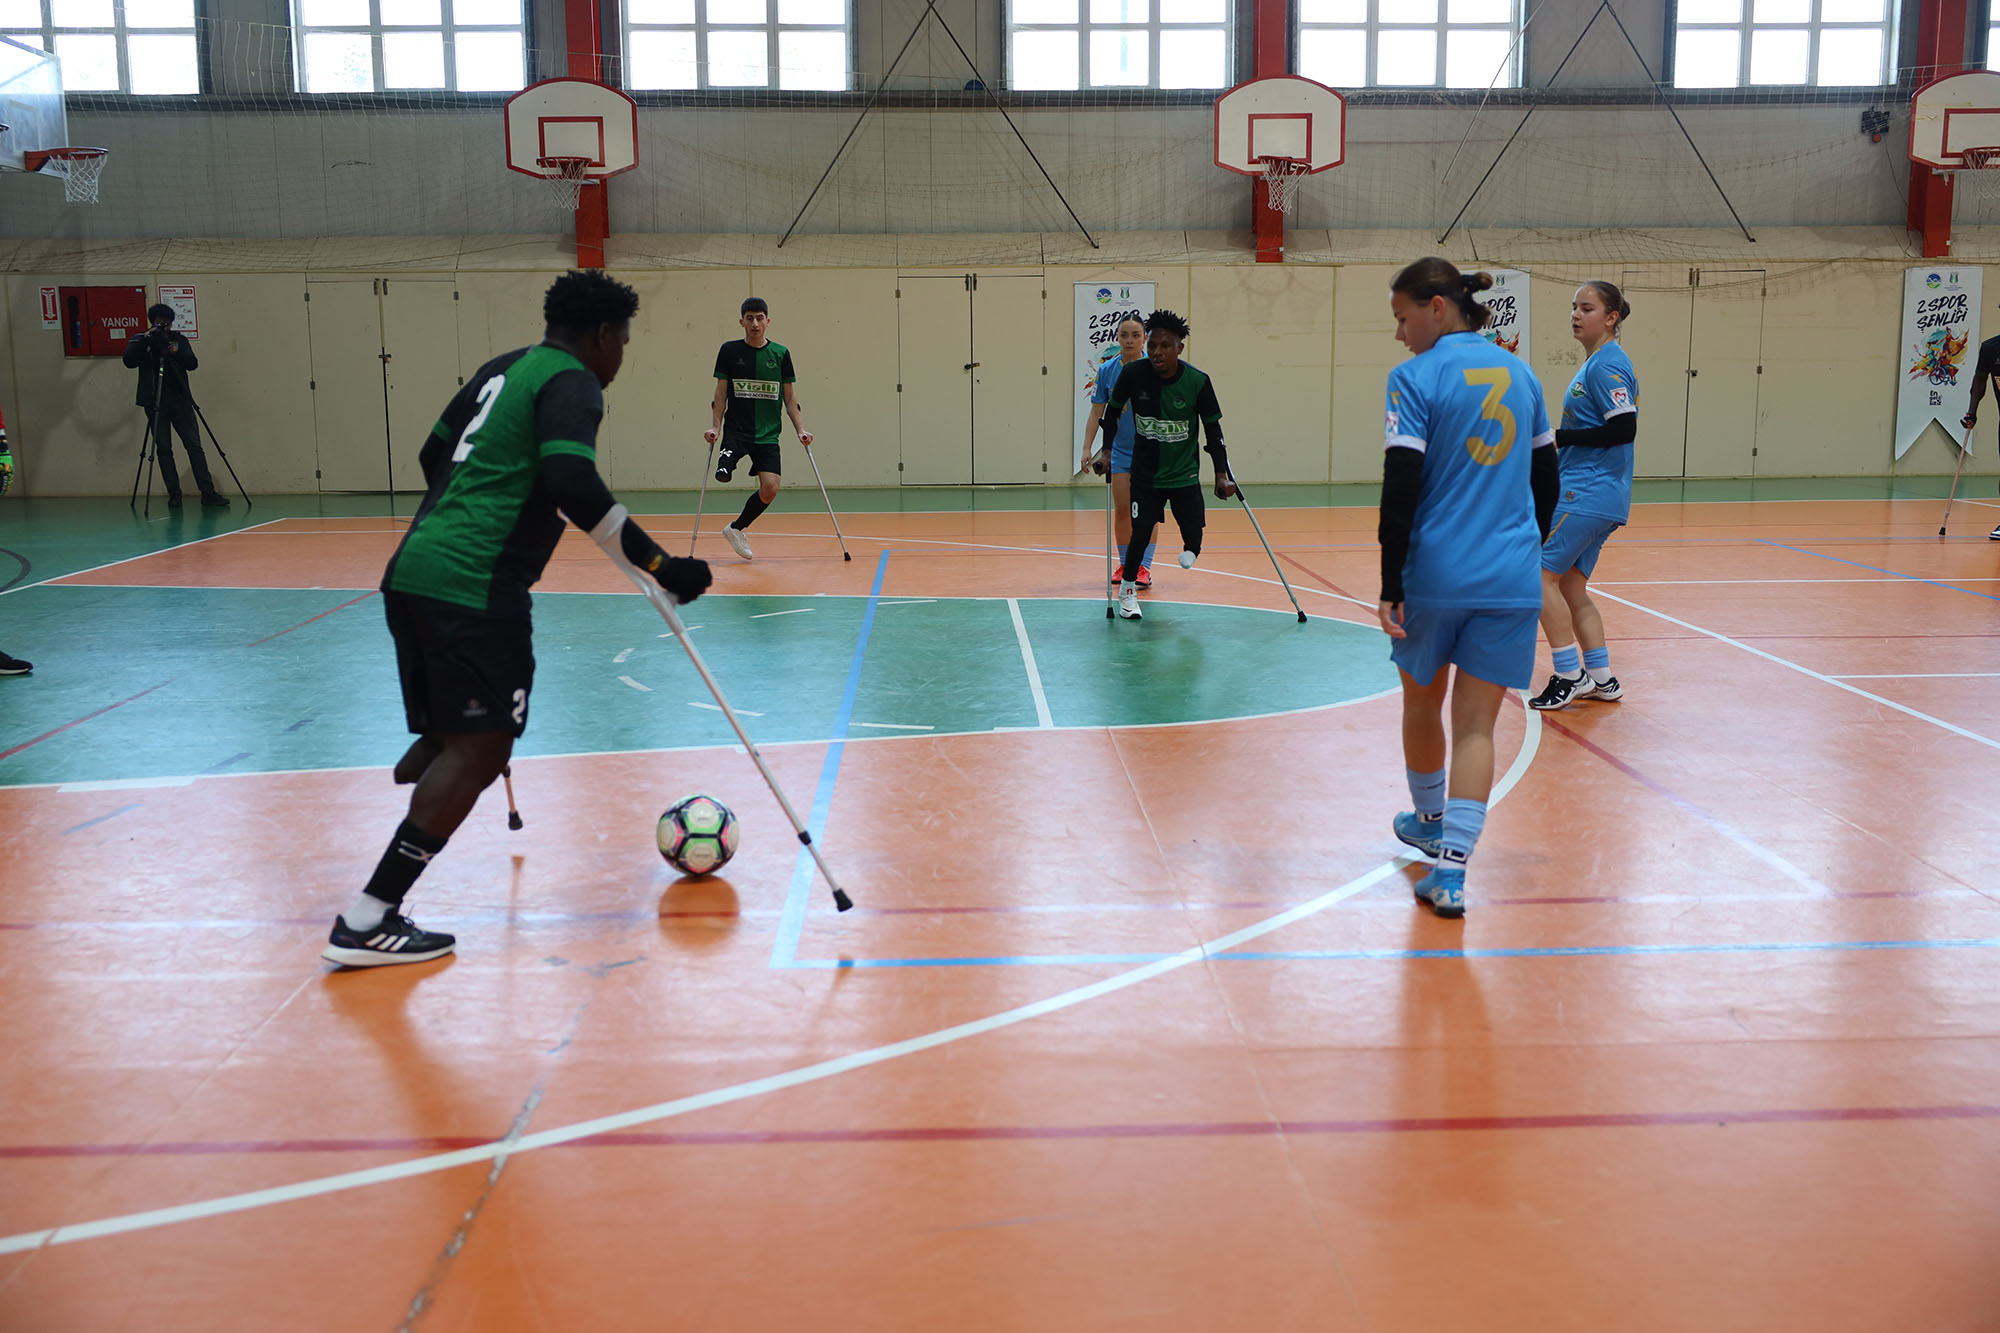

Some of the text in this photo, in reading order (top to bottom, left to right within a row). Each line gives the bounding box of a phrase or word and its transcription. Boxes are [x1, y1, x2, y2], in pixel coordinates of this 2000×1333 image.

[1481, 295, 1515, 312] POR
[1927, 294, 1967, 312] SPOR
[101, 317, 139, 327] YANGIN
[1917, 307, 1968, 331] ŞENLİĞİ
[452, 374, 506, 462] 2
[1463, 366, 1517, 466] 3
[1132, 501, 1139, 518] 8
[512, 689, 526, 724] 2
